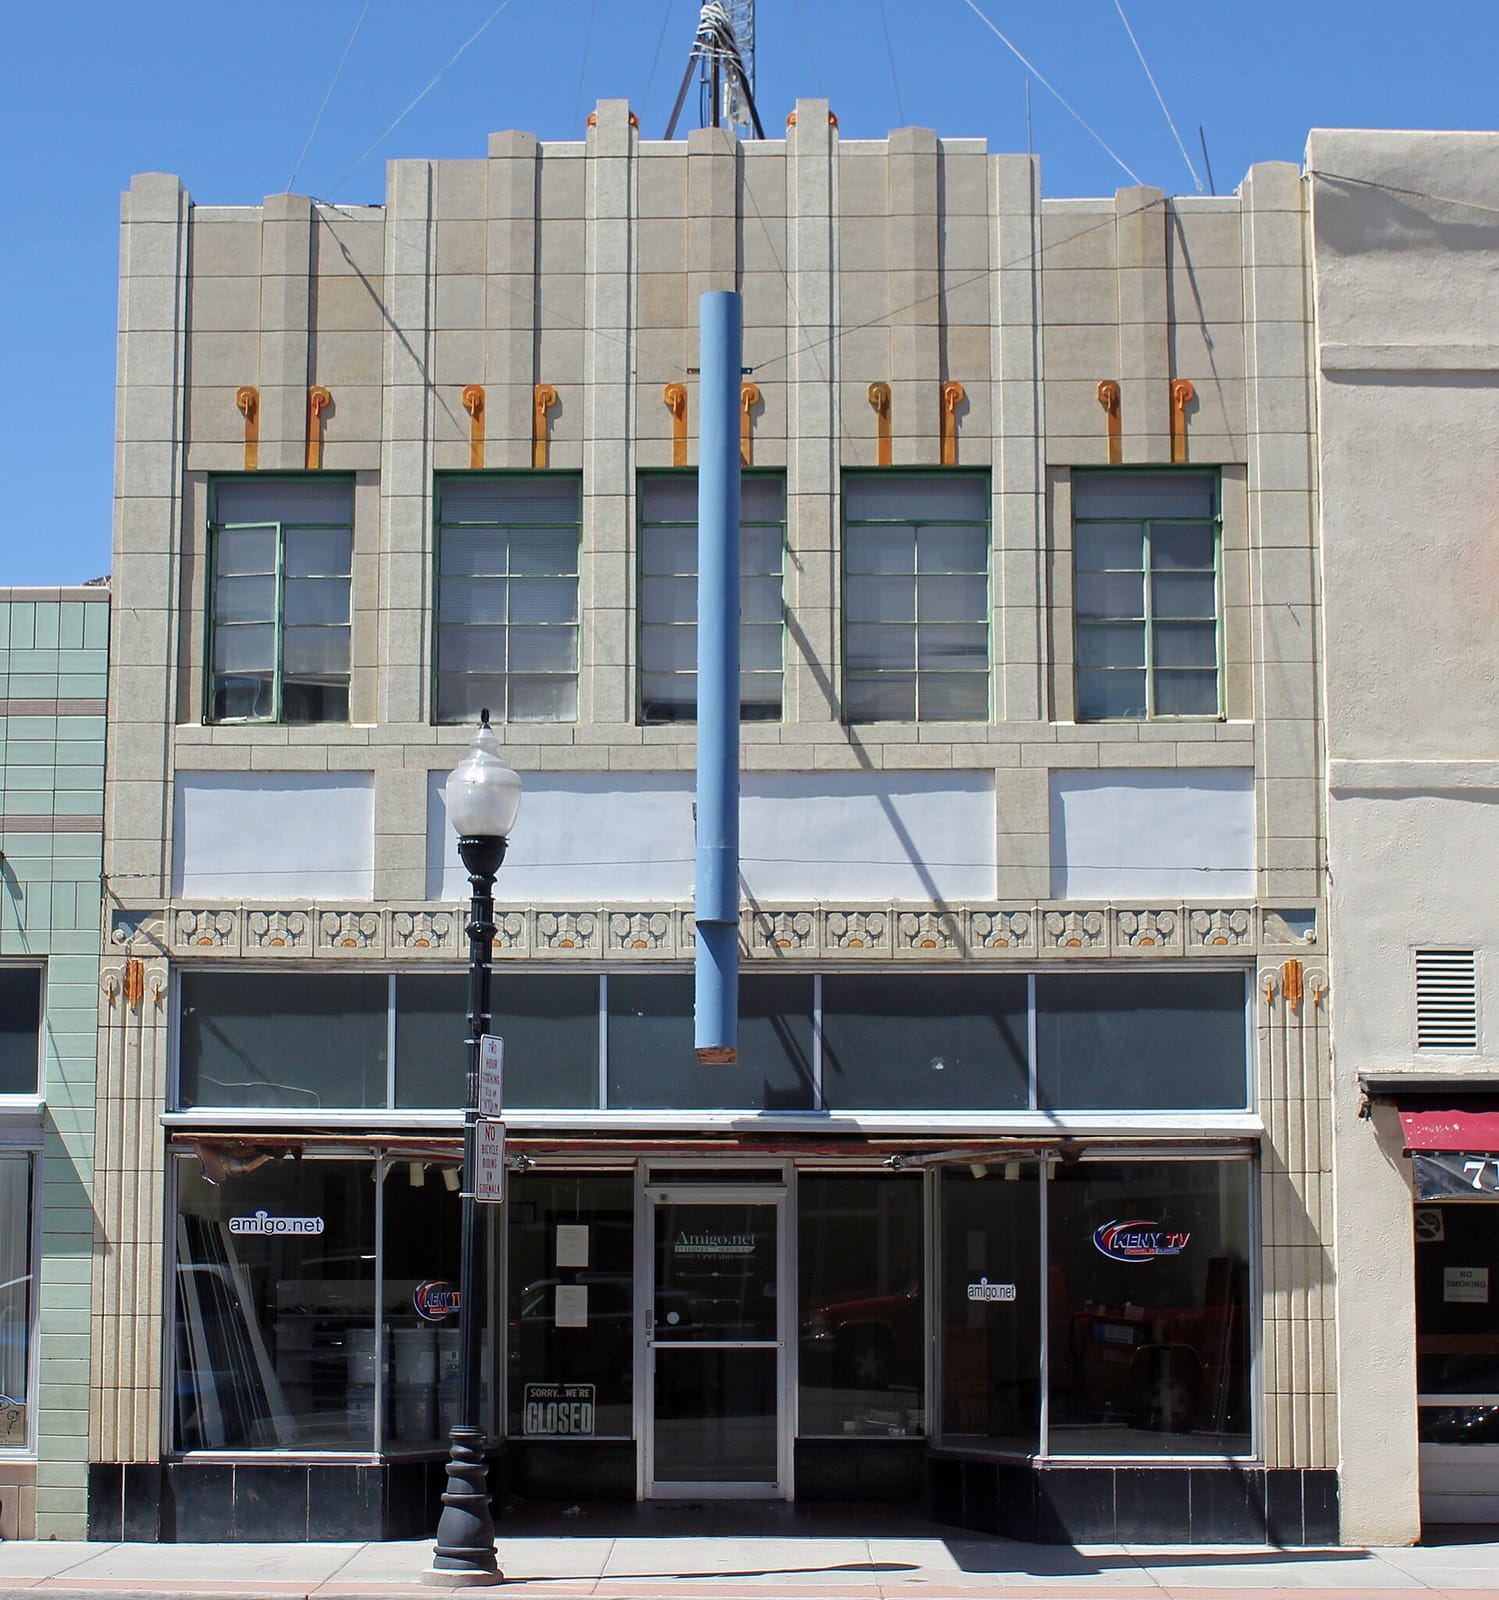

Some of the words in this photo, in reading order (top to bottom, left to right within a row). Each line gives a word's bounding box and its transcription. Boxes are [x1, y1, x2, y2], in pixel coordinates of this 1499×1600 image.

[485, 1126, 496, 1141] NO
[481, 1144, 499, 1155] BICYCLE
[482, 1158, 497, 1169] RIDING
[487, 1171, 493, 1182] ON
[479, 1183, 500, 1194] SIDEWALK
[230, 1213, 321, 1233] amigo.net
[676, 1230, 755, 1246] Amigo.net
[1113, 1232, 1163, 1248] KENY
[1166, 1232, 1191, 1248] TV
[968, 1280, 1014, 1299] amigo.net
[1447, 1280, 1486, 1288] SMOKING
[527, 1402, 592, 1433] CLOSED
